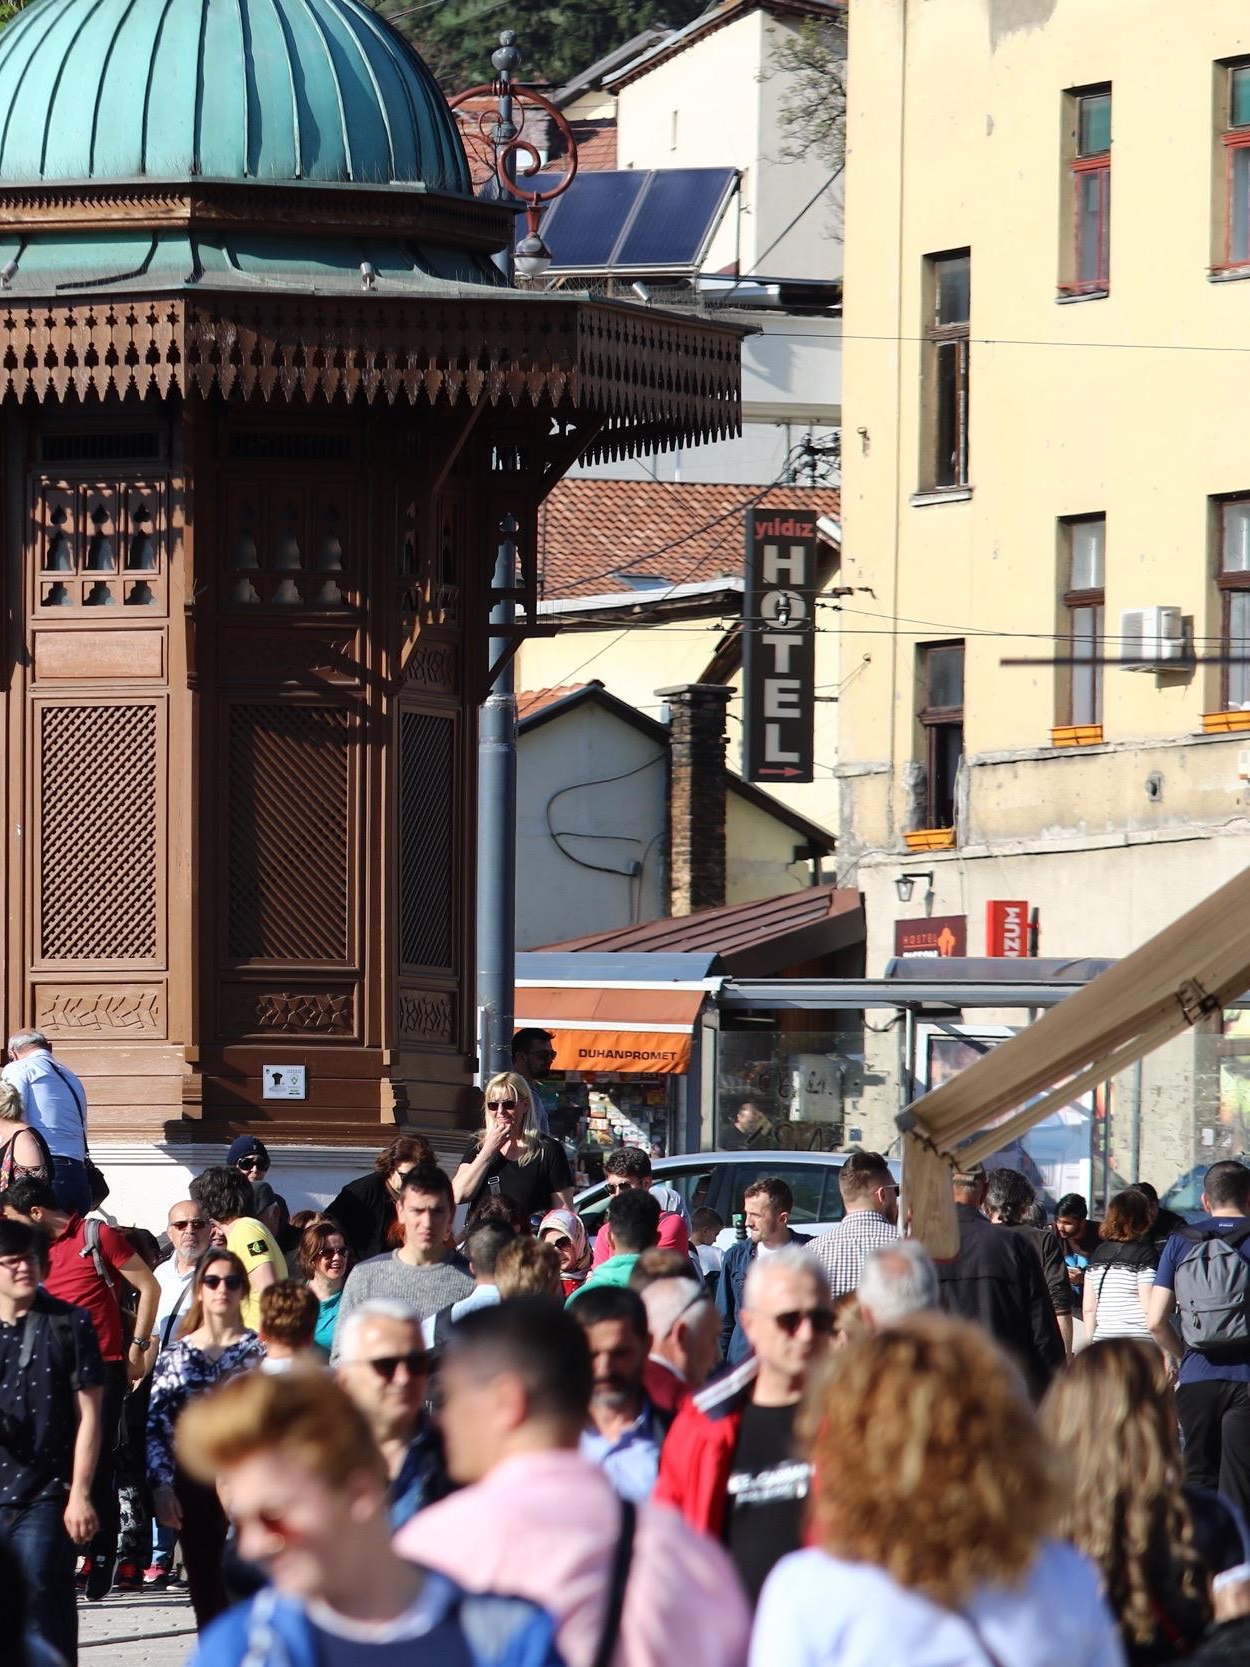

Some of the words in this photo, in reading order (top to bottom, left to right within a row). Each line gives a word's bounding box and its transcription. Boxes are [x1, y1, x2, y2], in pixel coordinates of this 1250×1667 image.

[760, 544, 806, 763] HOTEL
[902, 933, 938, 945] HOSTEL
[578, 1048, 678, 1061] DUHANPROMET
